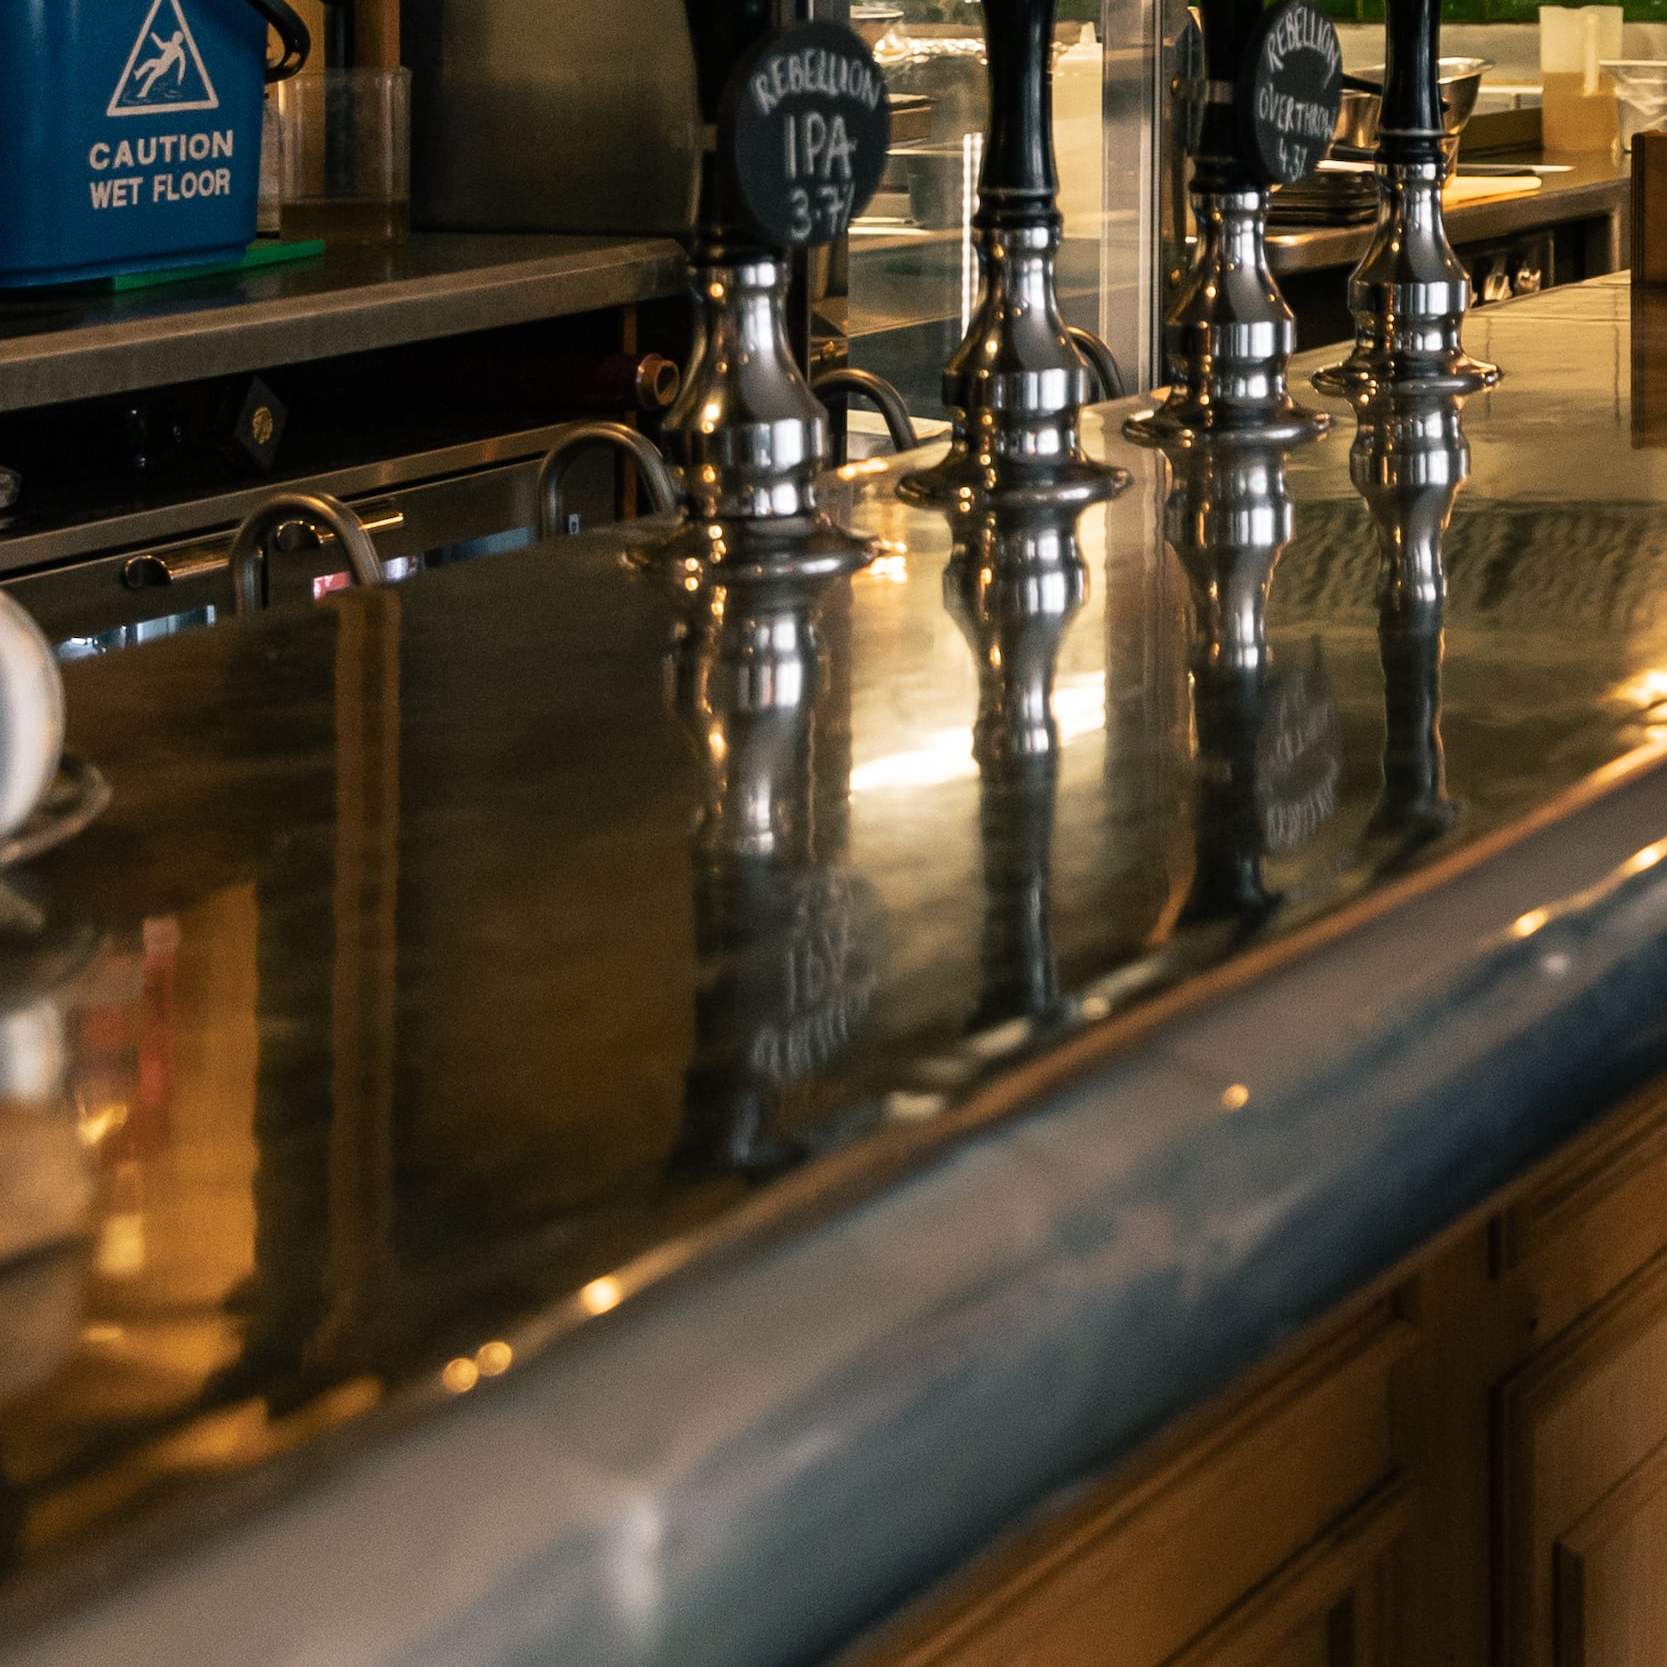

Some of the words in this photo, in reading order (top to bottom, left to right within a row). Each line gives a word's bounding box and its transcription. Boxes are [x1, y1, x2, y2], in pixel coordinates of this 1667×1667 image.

[1267, 5, 1339, 89] REBELLION
[755, 48, 881, 115] REBELLION
[89, 130, 234, 170] CAUTION
[786, 112, 856, 180] IPA
[90, 177, 144, 210] WET
[153, 168, 231, 202] FLOOR
